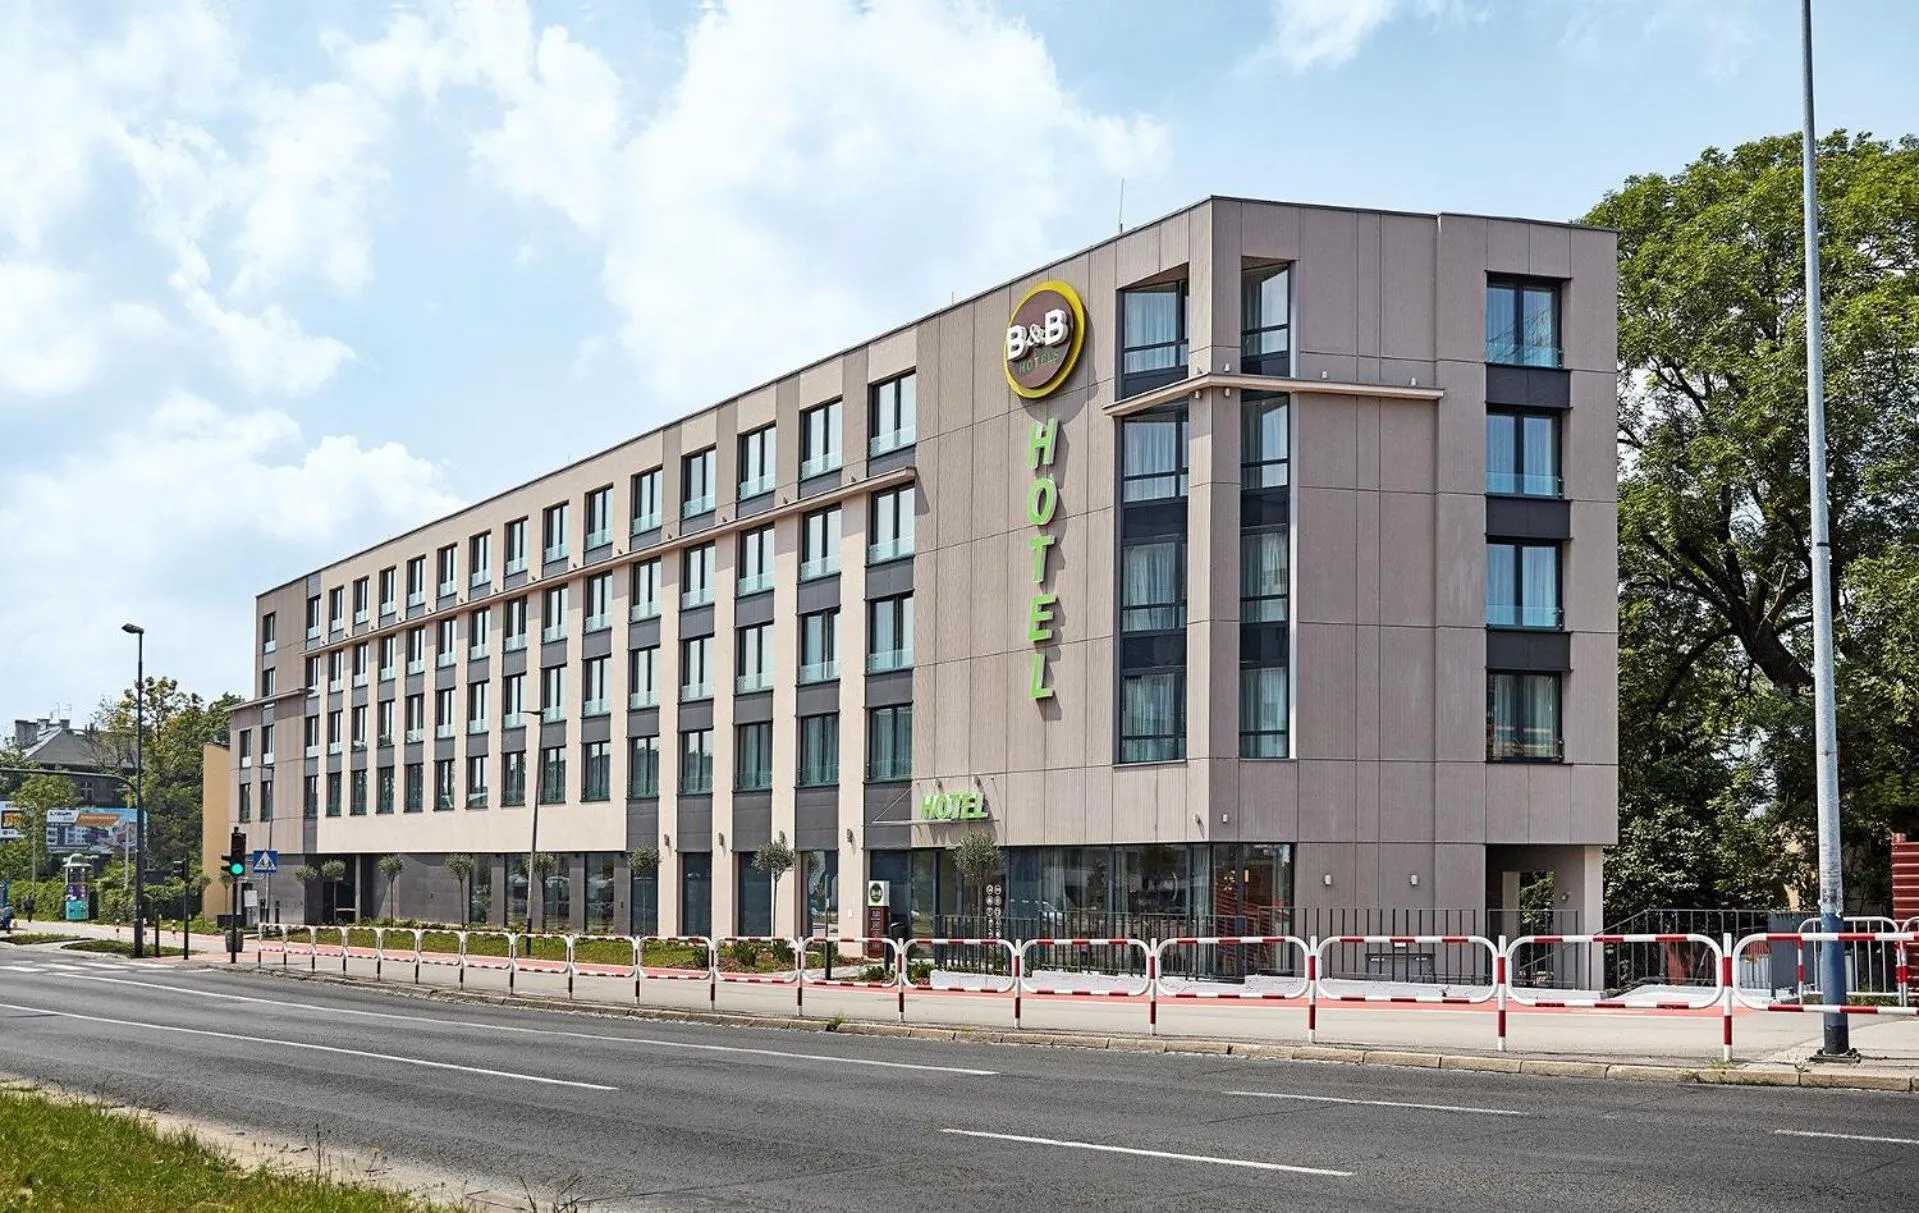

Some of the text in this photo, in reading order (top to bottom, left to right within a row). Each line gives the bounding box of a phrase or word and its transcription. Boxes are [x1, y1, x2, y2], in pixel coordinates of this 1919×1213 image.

[1006, 309, 1068, 361] B&B
[1026, 417, 1059, 700] HOTEL
[920, 791, 989, 821] HOTEL
